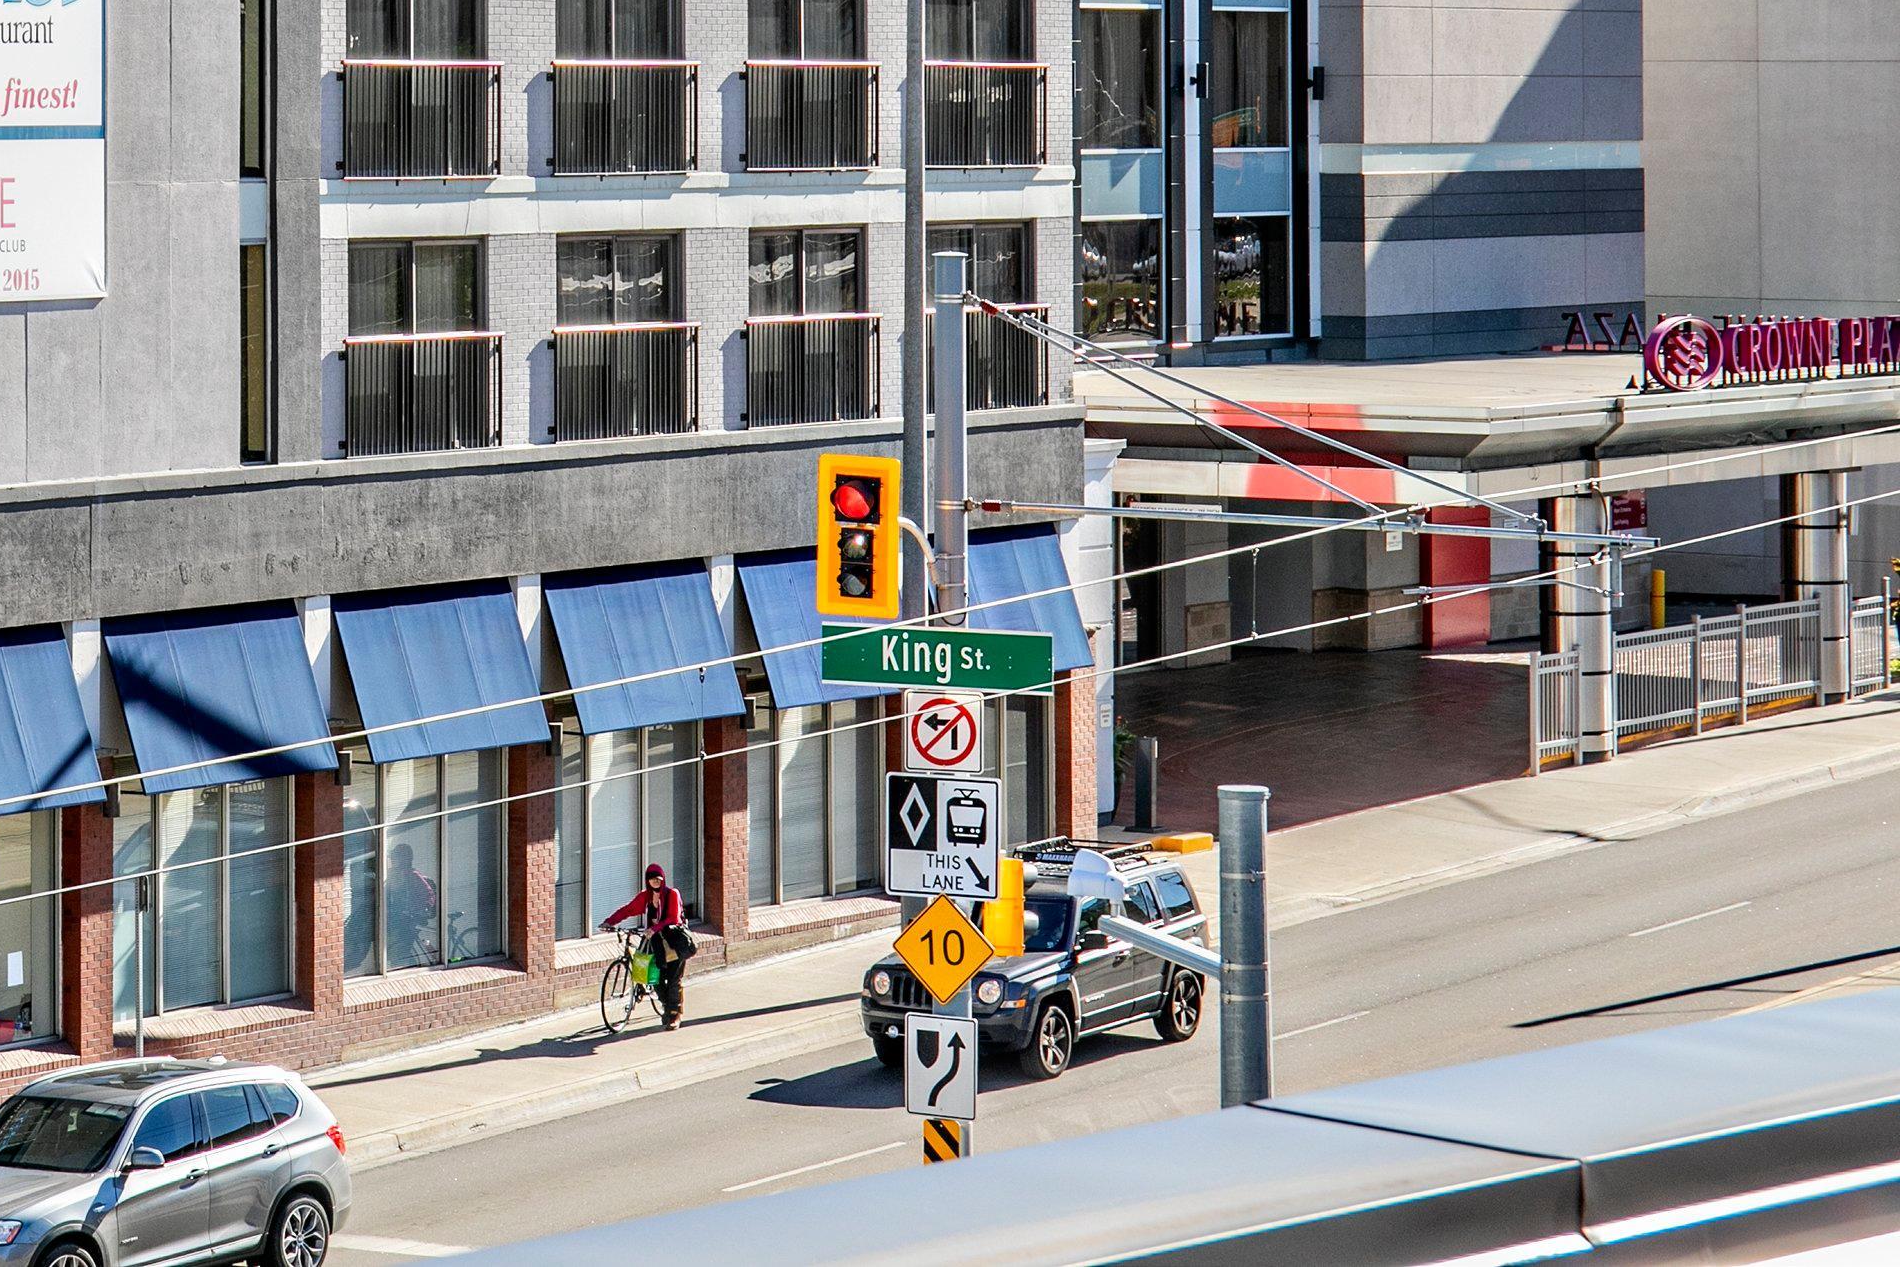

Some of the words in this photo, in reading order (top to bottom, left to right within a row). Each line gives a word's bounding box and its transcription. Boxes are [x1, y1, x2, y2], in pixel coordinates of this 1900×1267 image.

[1, 78, 78, 117] finest!
[0, 239, 26, 254] CLUB
[3, 269, 40, 291] 2015
[882, 632, 952, 684] King
[960, 645, 991, 671] St.
[926, 853, 961, 870] THIS
[922, 874, 964, 891] LANE
[920, 929, 965, 966] 10
